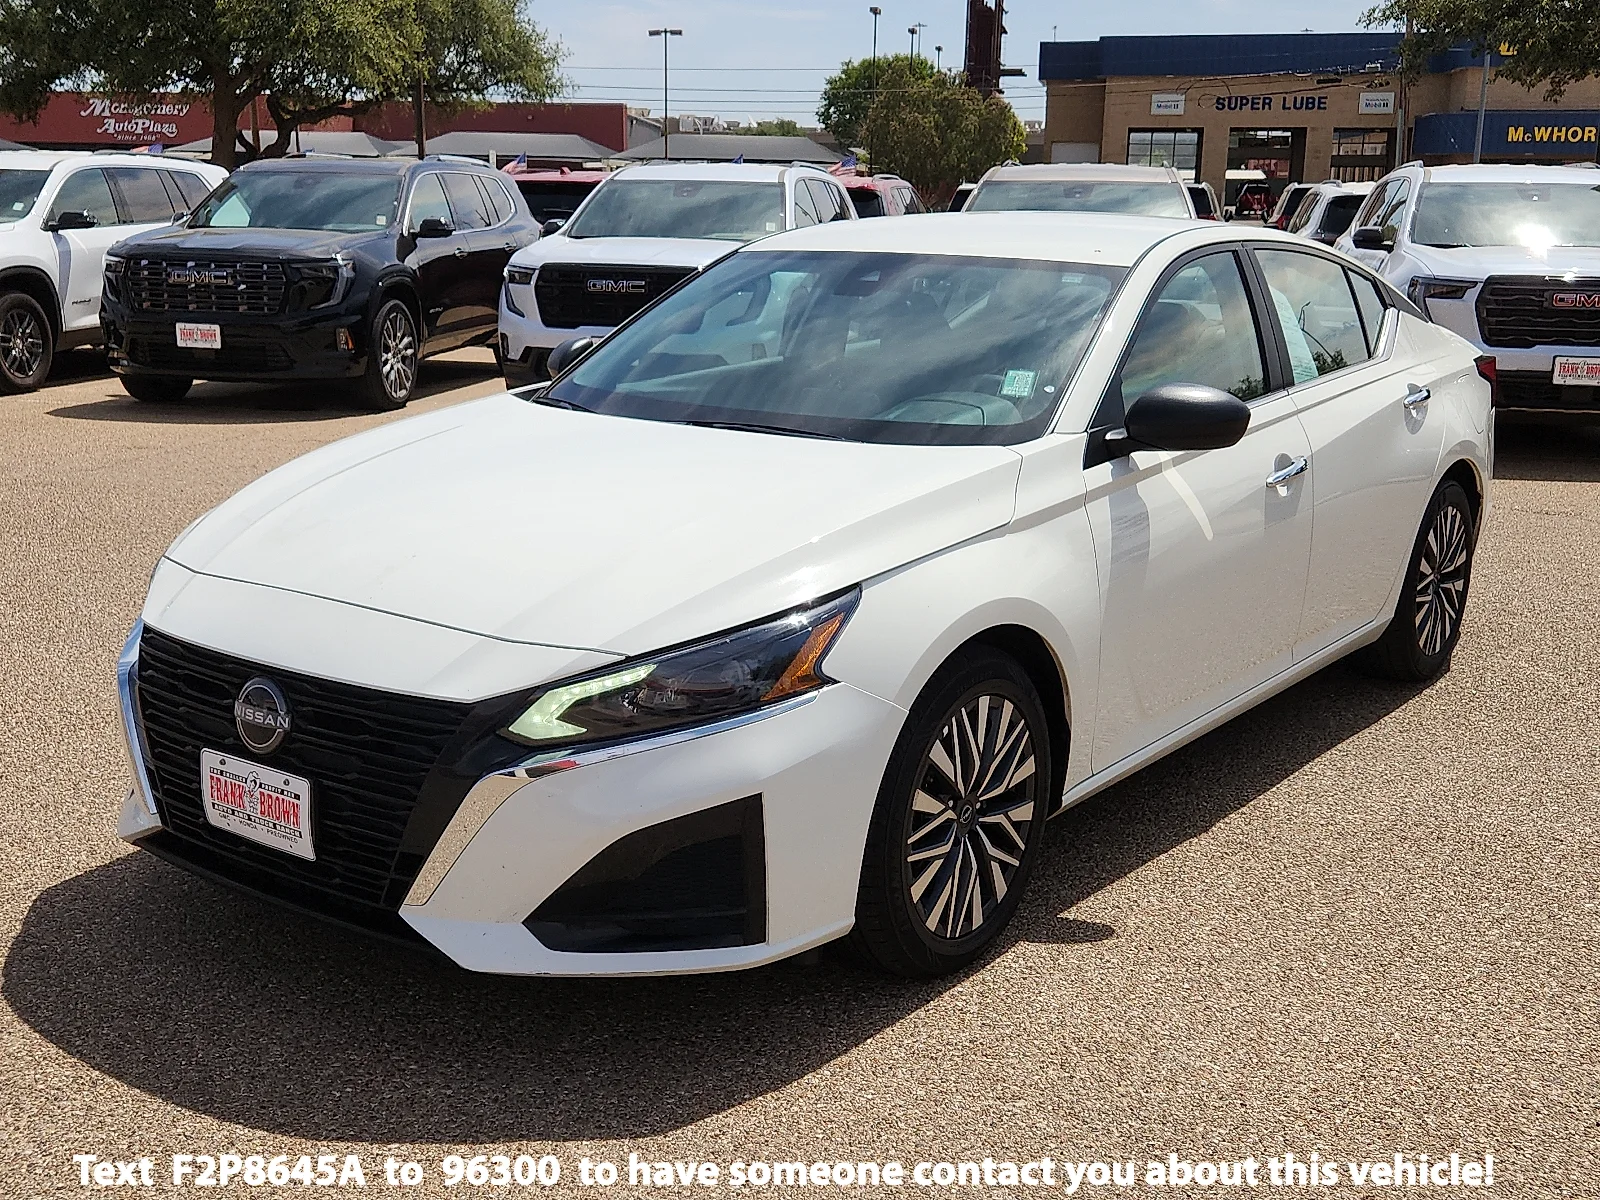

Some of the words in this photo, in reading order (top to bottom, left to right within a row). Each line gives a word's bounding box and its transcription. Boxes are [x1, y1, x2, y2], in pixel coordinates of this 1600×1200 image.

[1215, 96, 1273, 111] SUPER
[1282, 96, 1328, 111] LUBE
[168, 270, 228, 284] GMC
[587, 279, 646, 293] GMC
[1559, 362, 1580, 375] FRANK
[234, 701, 289, 728] NISSAN
[209, 775, 247, 810] FRANK
[258, 790, 301, 830] BROWN
[214, 803, 232, 815] AUTO
[233, 810, 249, 820] AND
[249, 815, 275, 829] TRUCK
[275, 824, 301, 838] RANCH
